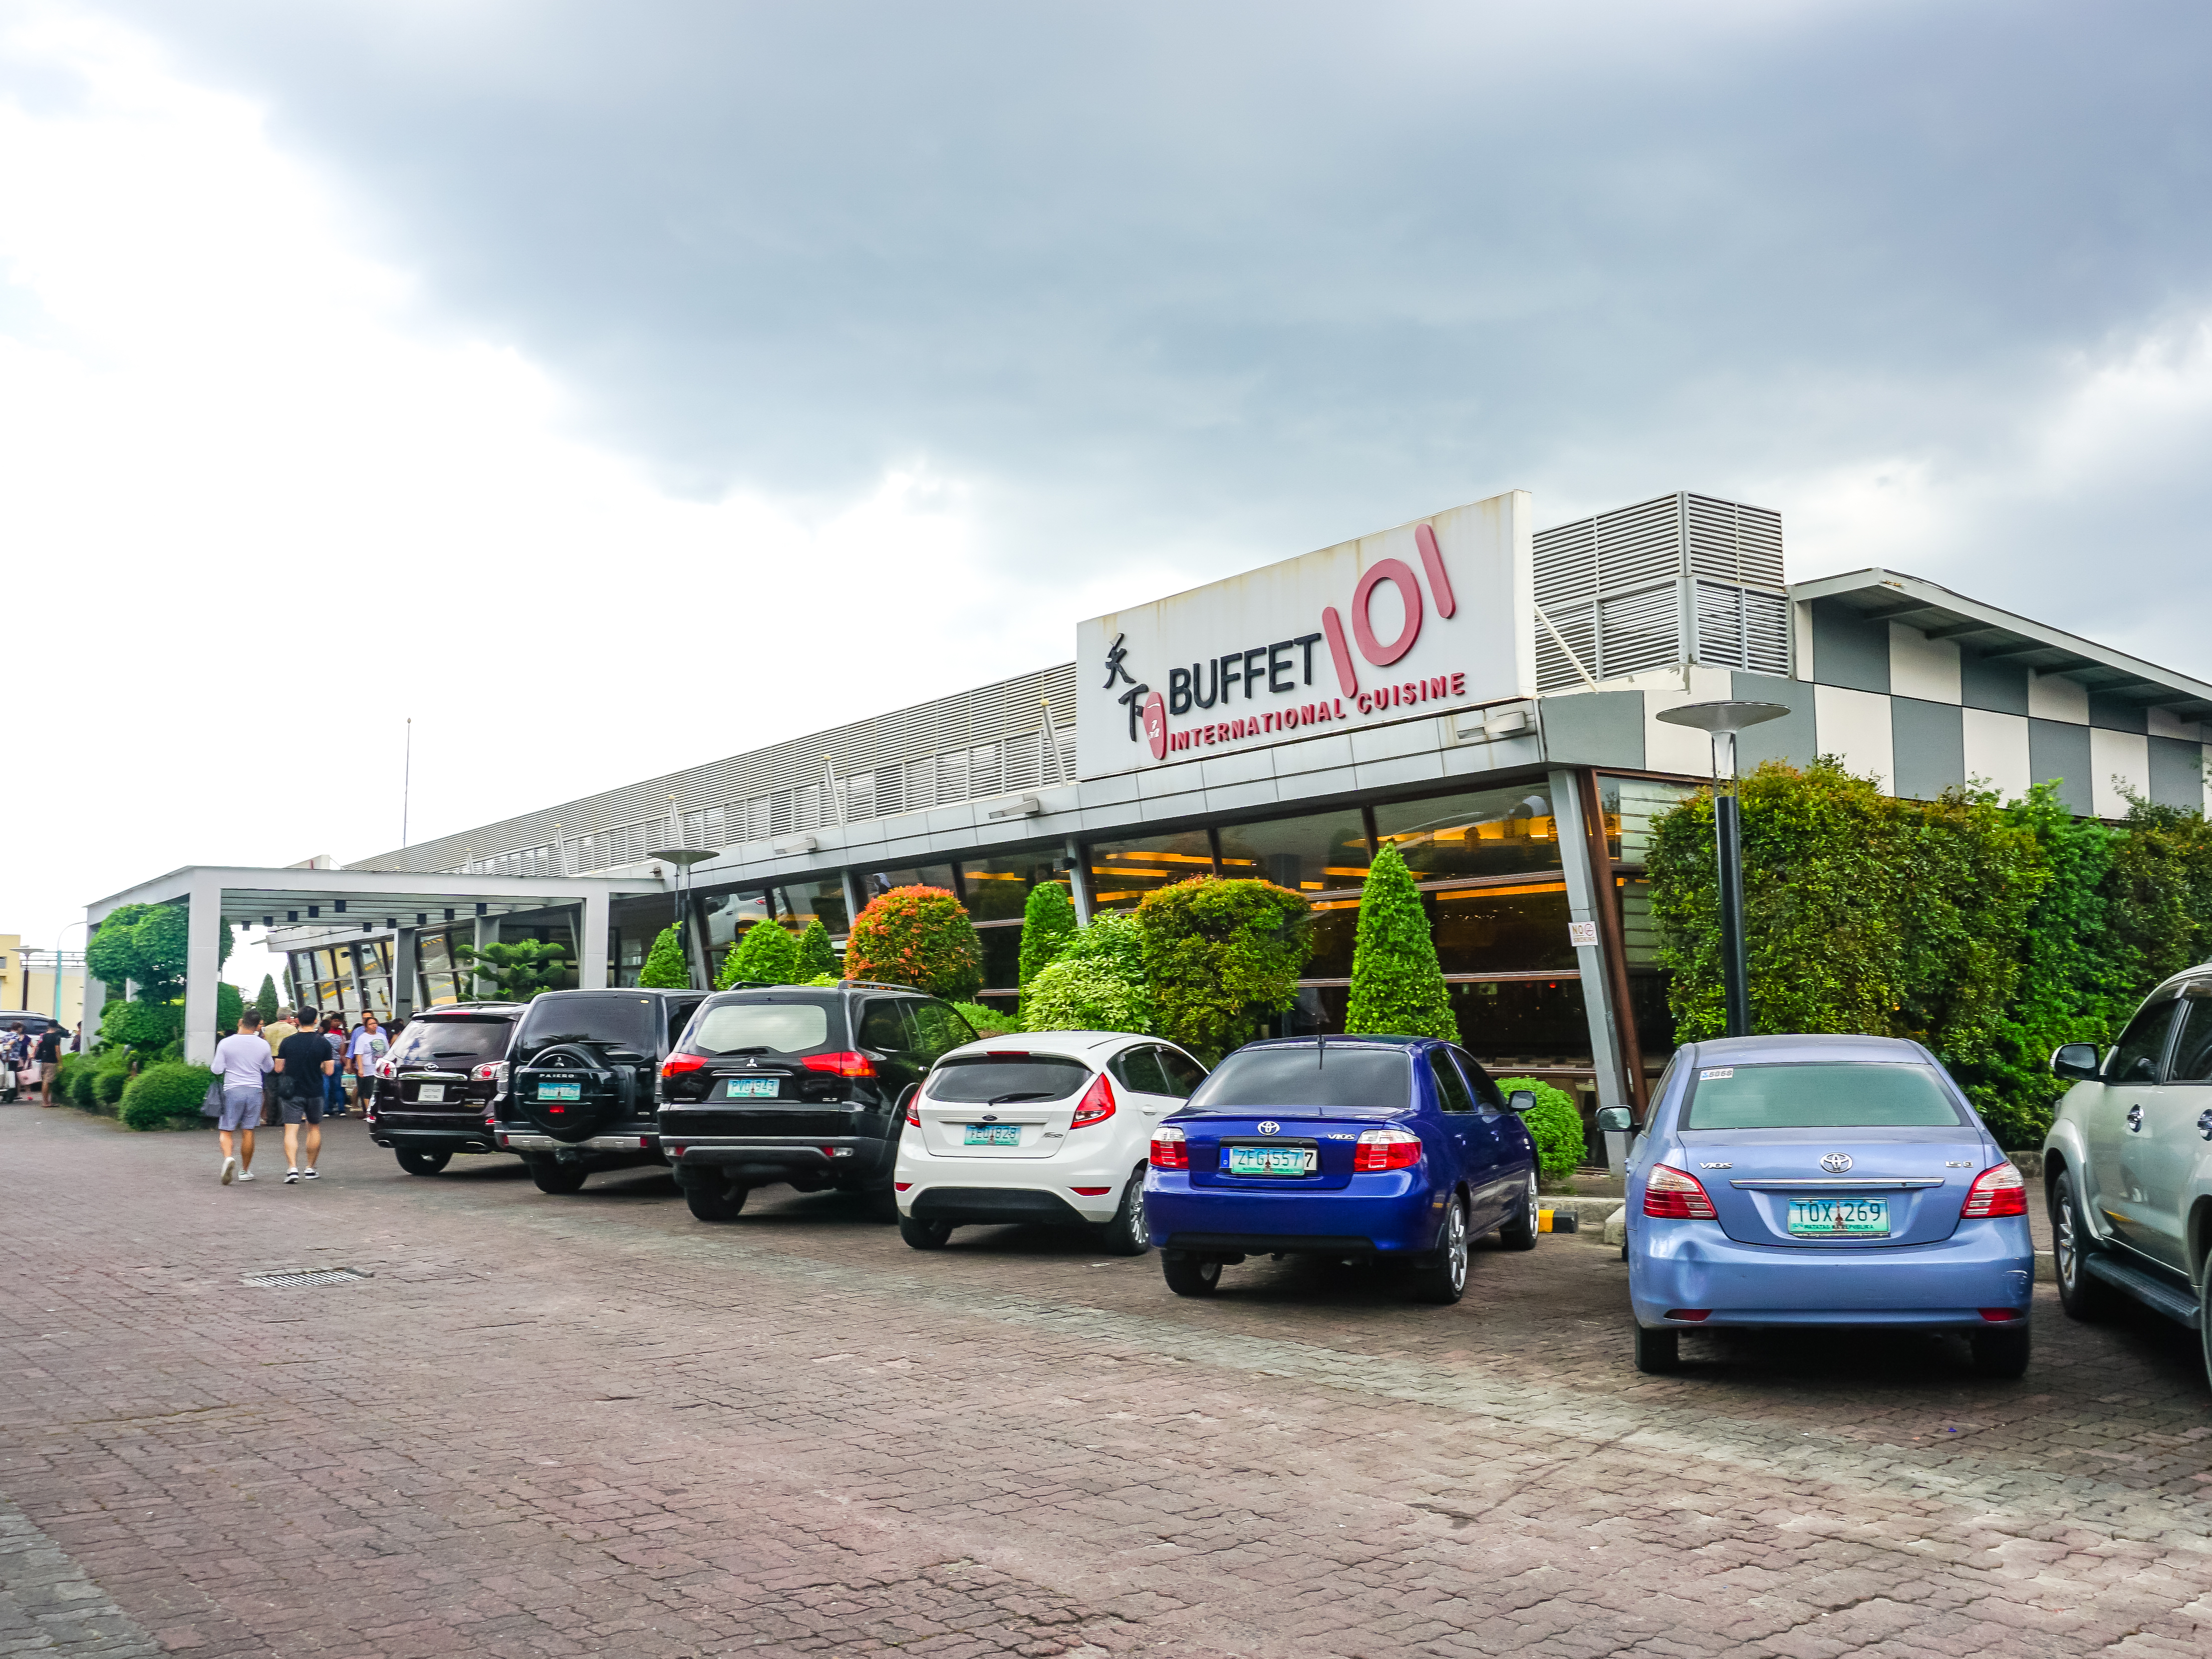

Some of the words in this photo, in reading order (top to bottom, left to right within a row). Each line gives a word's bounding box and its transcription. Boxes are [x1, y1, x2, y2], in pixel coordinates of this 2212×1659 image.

[1169, 632, 1322, 716] BUFFET
[1322, 523, 1456, 699] 101
[1170, 698, 1347, 752] INTERNATIONAL
[1357, 672, 1465, 715] CUISINE
[1572, 925, 1584, 934] NO
[1238, 1150, 1265, 1165] ZFG
[1272, 1151, 1299, 1166] 557
[1304, 1152, 1314, 1167] 7
[1796, 1203, 1833, 1222] TOX
[1844, 1203, 1880, 1221] 269
